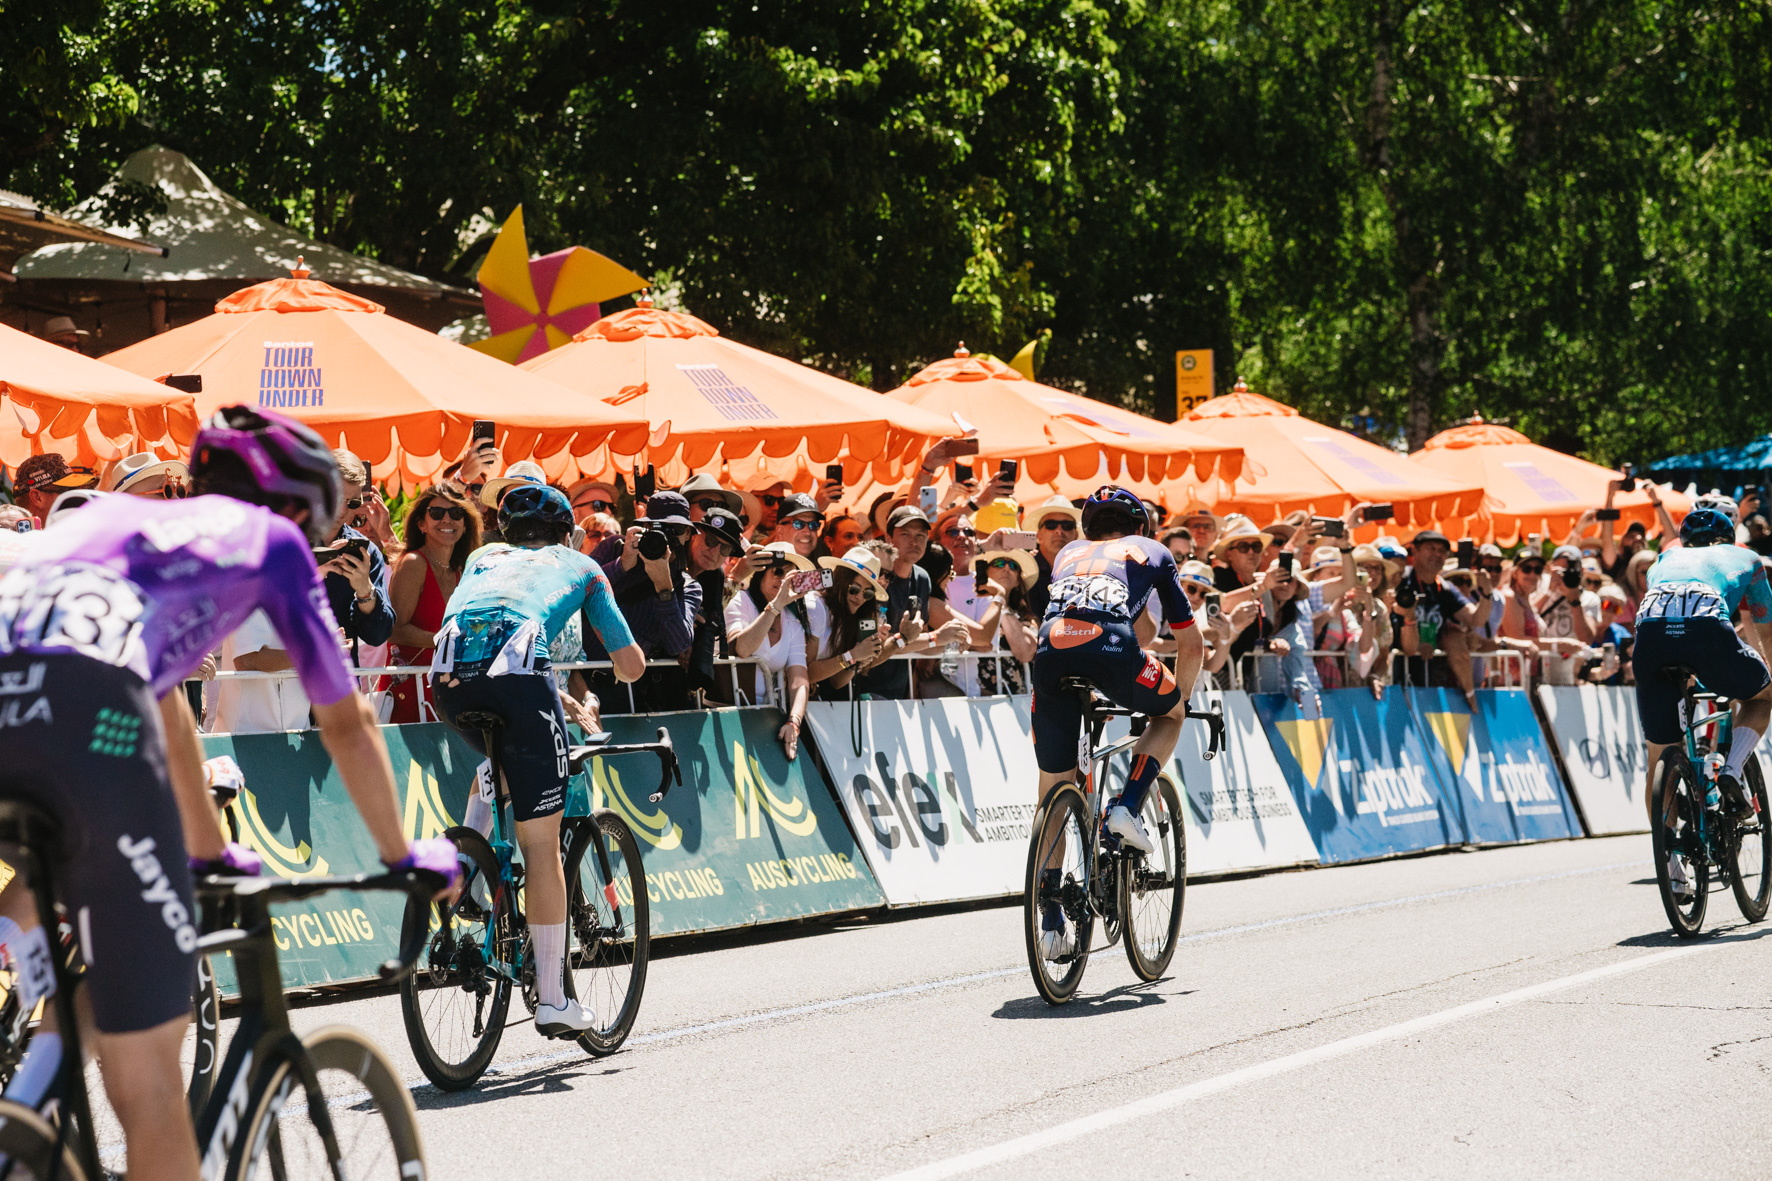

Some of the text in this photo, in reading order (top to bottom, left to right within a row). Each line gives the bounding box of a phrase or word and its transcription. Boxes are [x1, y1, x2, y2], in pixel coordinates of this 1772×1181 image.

[264, 347, 313, 368] TOUR
[260, 368, 321, 389] DOWN
[679, 368, 734, 387] TOUR
[259, 389, 324, 408] UNDER
[697, 386, 759, 404] DOWN
[714, 403, 779, 421] UNDER
[543, 582, 581, 607] ASTANA
[1102, 644, 1123, 653] Nalini
[538, 709, 569, 778] SPX
[533, 799, 563, 812] ASTANA
[974, 803, 1037, 823] SMARTER TE
[985, 824, 1032, 843] AMBITIO
[746, 852, 857, 892] AUSCYCLING
[116, 833, 197, 954] Jayco
[613, 867, 724, 907] UCYCLING
[271, 908, 374, 951] CYCLING
